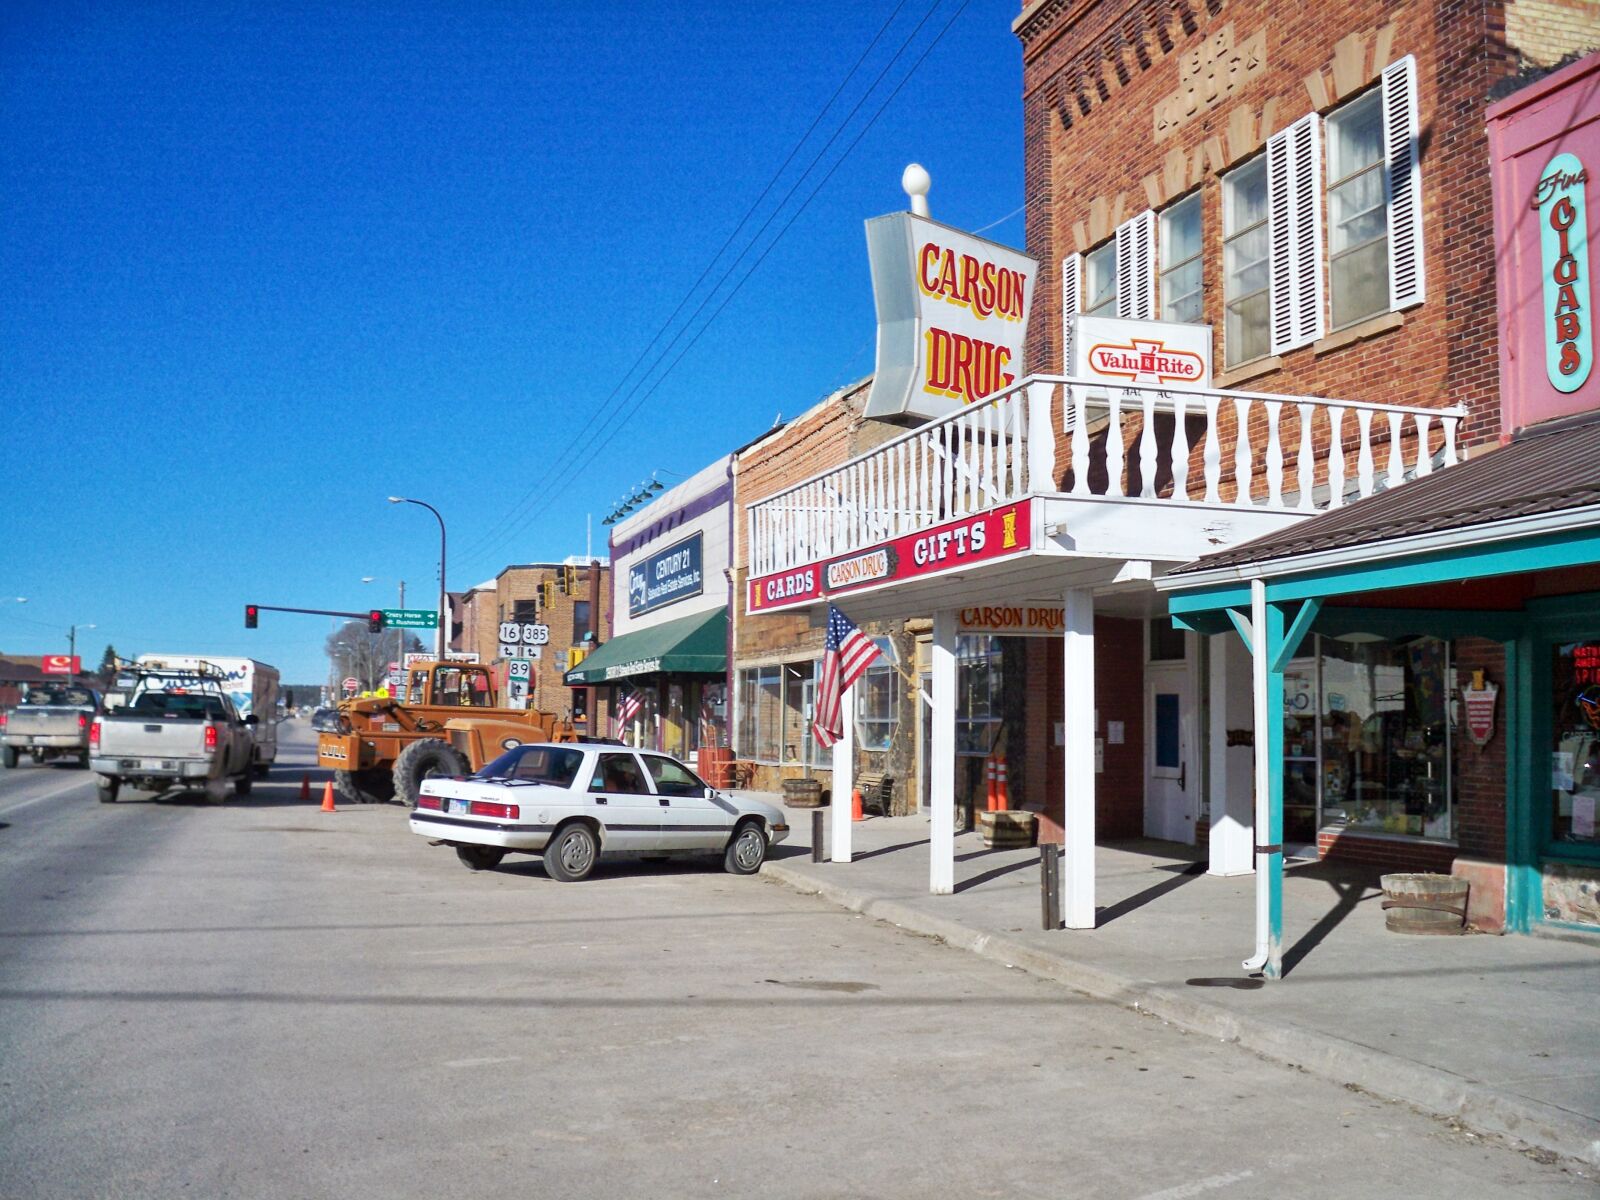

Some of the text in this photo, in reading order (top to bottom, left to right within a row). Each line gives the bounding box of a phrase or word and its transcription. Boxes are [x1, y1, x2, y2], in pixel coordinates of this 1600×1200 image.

[1531, 169, 1588, 209] Fine
[919, 242, 1027, 324] CARSON
[1550, 196, 1581, 376] CIGARS
[925, 327, 1015, 405] DRUG
[1098, 351, 1139, 370] Valu
[1156, 356, 1194, 375] Rite
[655, 548, 690, 580] CENTURY 21
[768, 521, 986, 600] CARDS CARSON DRUG GIFTS
[384, 611, 422, 619] Crazy Horse
[961, 607, 1023, 629] CARSON
[503, 626, 546, 641] 16 385
[510, 663, 529, 675] 89
[320, 743, 348, 760] LULL
